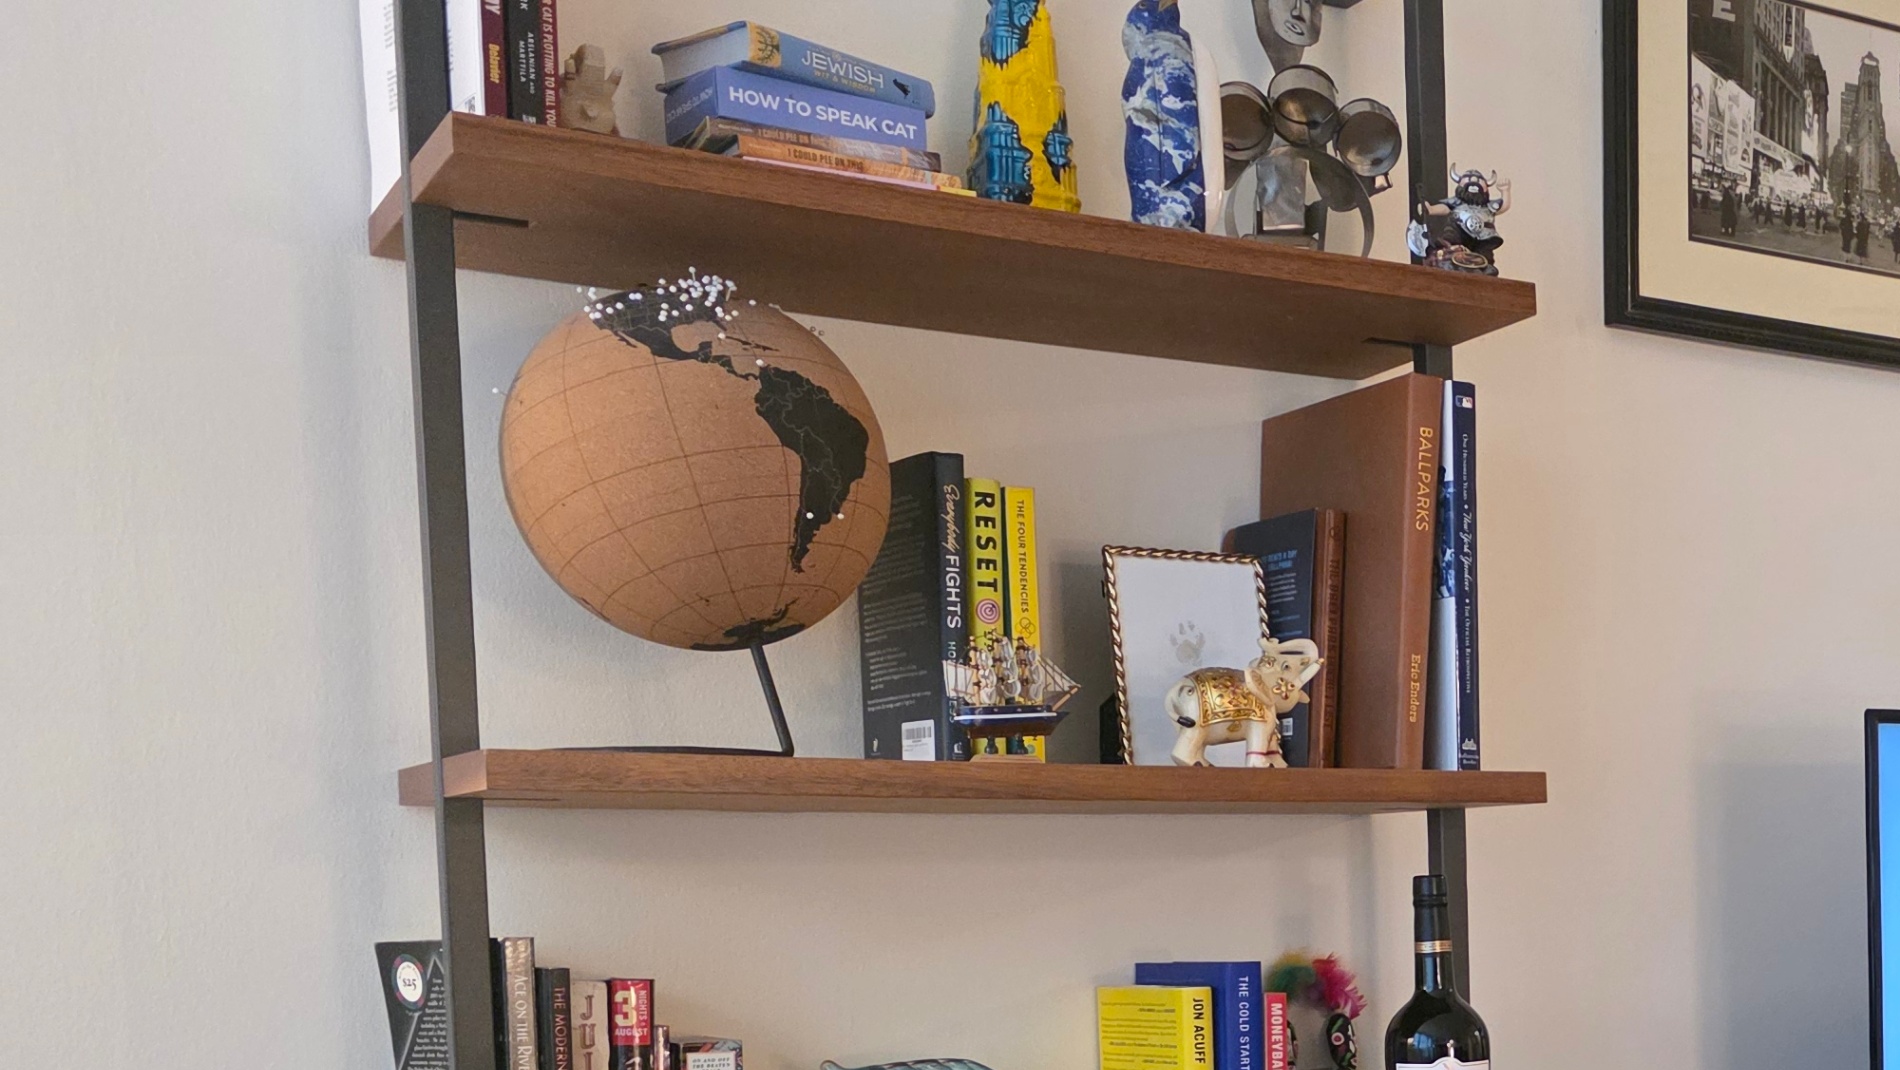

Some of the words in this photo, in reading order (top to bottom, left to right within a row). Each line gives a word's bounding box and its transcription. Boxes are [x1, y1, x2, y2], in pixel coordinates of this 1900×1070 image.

[541, 5, 553, 23] CAT
[542, 23, 554, 33] IS
[488, 43, 500, 84] Delavier
[518, 39, 527, 83] MARTTILA
[543, 33, 555, 75] PLOTTING
[544, 77, 556, 90] TO
[801, 50, 885, 89] JEWISH
[545, 90, 556, 107] KILL
[728, 85, 781, 111] HOW
[784, 96, 812, 117] TO
[815, 103, 880, 133] SPEAK
[881, 119, 918, 140] CAT
[546, 109, 558, 129] YOU
[793, 149, 818, 162] COULD
[819, 153, 834, 166] PEE
[834, 156, 847, 168] ON
[1415, 426, 1434, 531] BALLPARKS
[940, 483, 961, 553] Everybody
[1016, 499, 1025, 519] THE
[974, 491, 998, 593] RESET
[1016, 520, 1027, 549] FOUR
[945, 554, 962, 629] FIGHTS
[1018, 551, 1030, 614] TENDENCIES
[1410, 653, 1421, 680] Eric
[1409, 680, 1421, 723] Enders
[402, 976, 417, 991] $25
[514, 974, 528, 997] ACE
[553, 986, 567, 1009] THE
[1238, 976, 1249, 998] THE
[514, 999, 528, 1019] ON
[614, 988, 638, 1027] 3
[638, 989, 648, 1021] NIGHTS
[1192, 997, 1205, 1020] JON
[1238, 1002, 1250, 1032] COLD
[516, 1023, 529, 1043] THE
[614, 1026, 648, 1037] AUGUST
[1193, 1025, 1207, 1064] ACUFF
[1239, 1036, 1250, 1070] START
